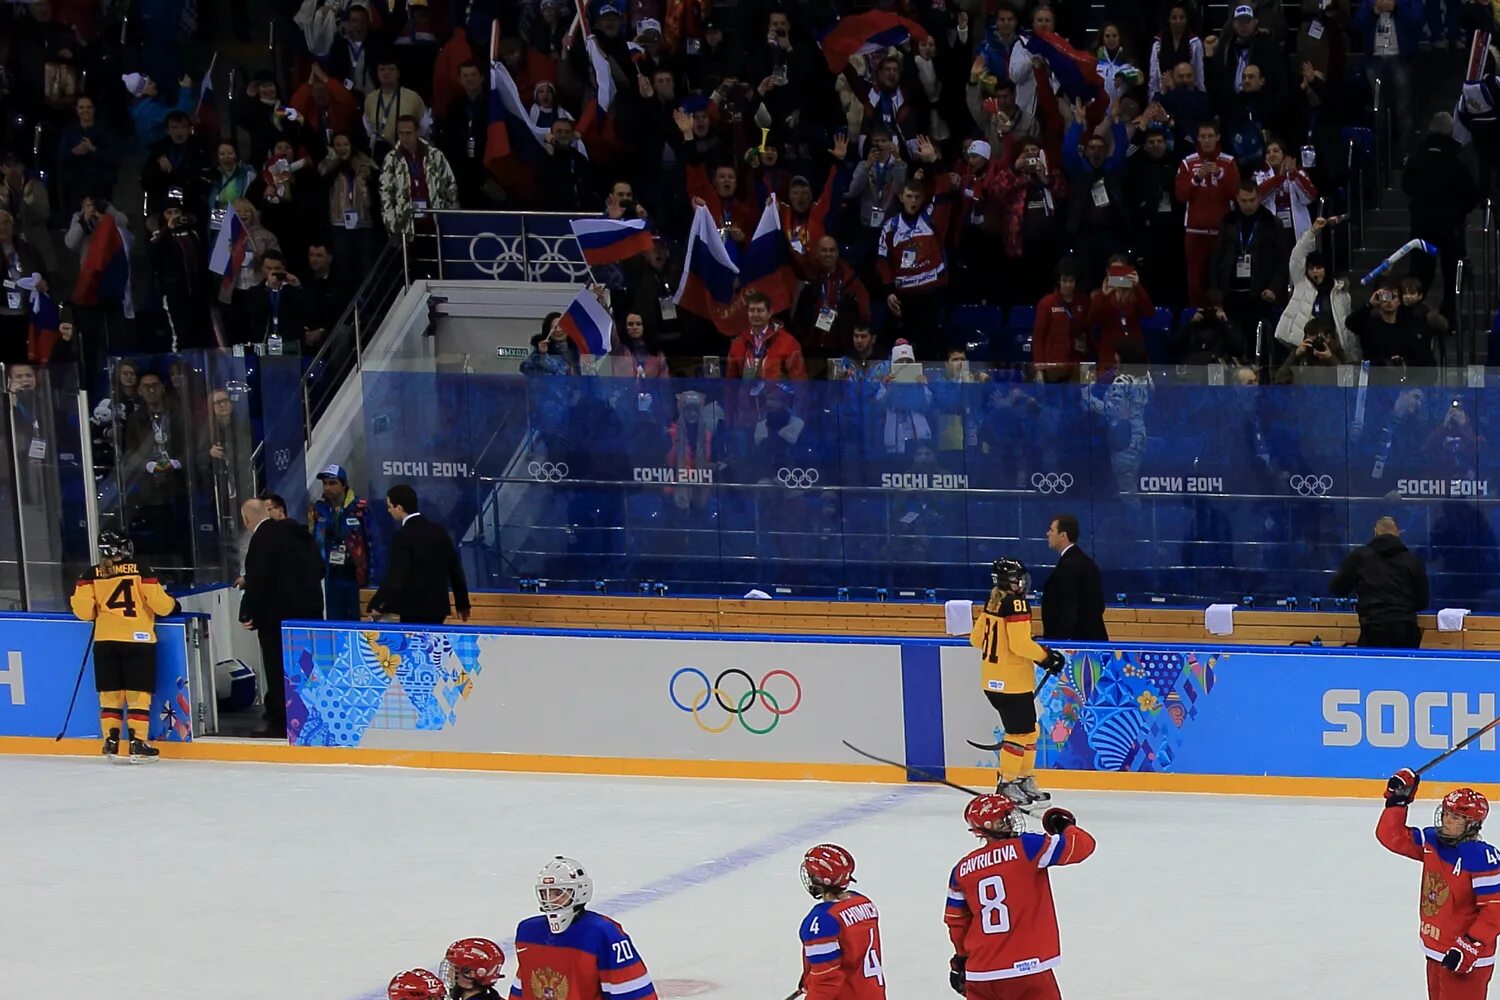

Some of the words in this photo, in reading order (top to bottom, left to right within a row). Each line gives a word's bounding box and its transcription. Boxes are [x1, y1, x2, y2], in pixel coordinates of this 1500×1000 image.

[382, 461, 428, 476] SOCHI
[432, 463, 468, 477] 2014
[633, 467, 674, 482] СОЧИ
[678, 469, 713, 483] 2014
[881, 473, 928, 488] SOCHI
[932, 475, 968, 489] 2014
[1140, 477, 1182, 491] СОЧИ
[1186, 478, 1223, 492] 2014
[1397, 479, 1445, 495] SOCHI
[1450, 480, 1488, 495] 2014
[96, 563, 139, 577] HMERL
[106, 579, 137, 617] 4
[1013, 601, 1027, 612] 81
[960, 845, 1018, 877] GAVRILOVA
[1452, 857, 1462, 876] A
[978, 875, 1010, 934] 8
[809, 916, 820, 934] 4
[612, 940, 634, 963] 20
[863, 928, 883, 987] 4
